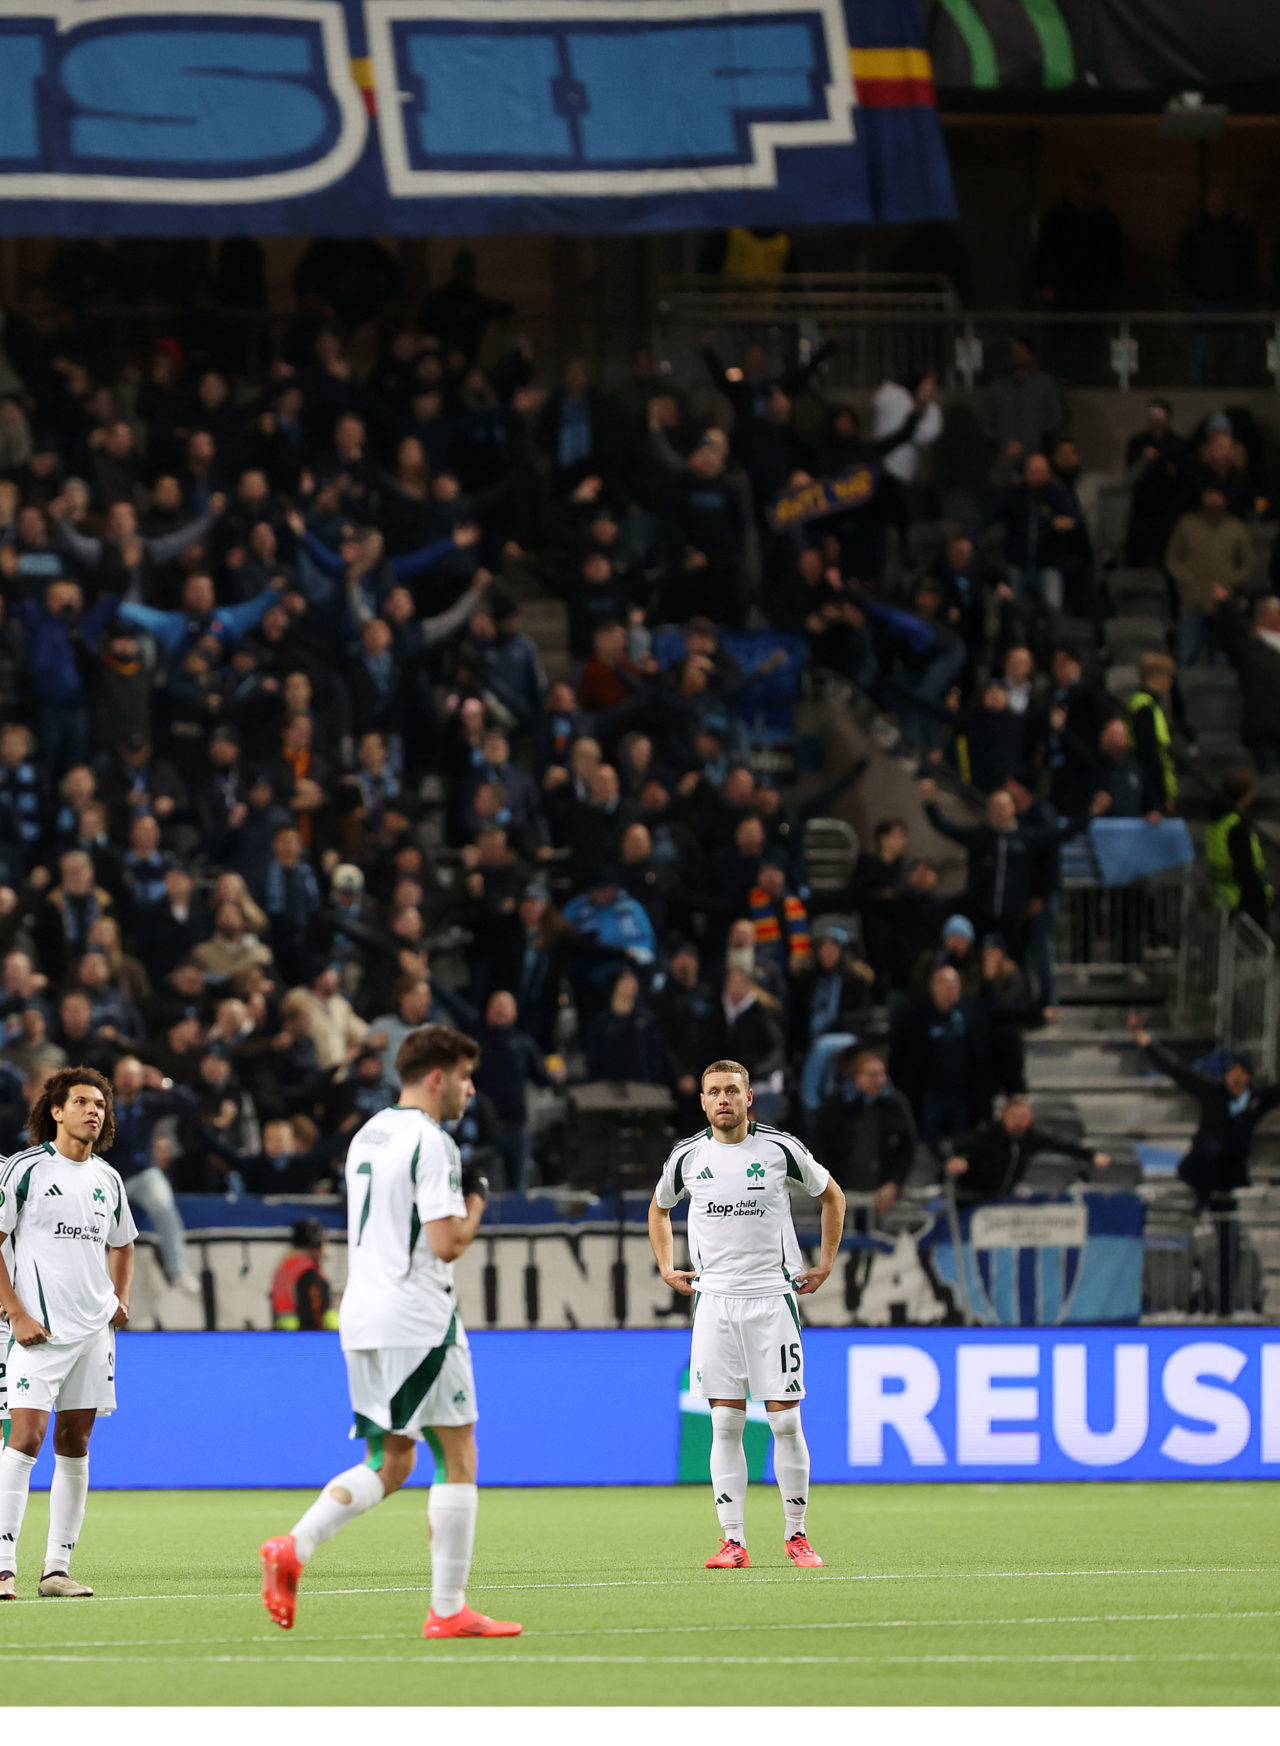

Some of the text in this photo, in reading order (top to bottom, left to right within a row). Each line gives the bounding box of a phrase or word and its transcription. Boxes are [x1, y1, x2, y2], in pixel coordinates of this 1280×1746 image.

[706, 1201, 733, 1216] Stop
[736, 1199, 757, 1208] child
[733, 1208, 766, 1217] obesity
[55, 1221, 82, 1239] Stop
[781, 1343, 801, 1373] 15
[847, 1342, 1280, 1467] REUS
